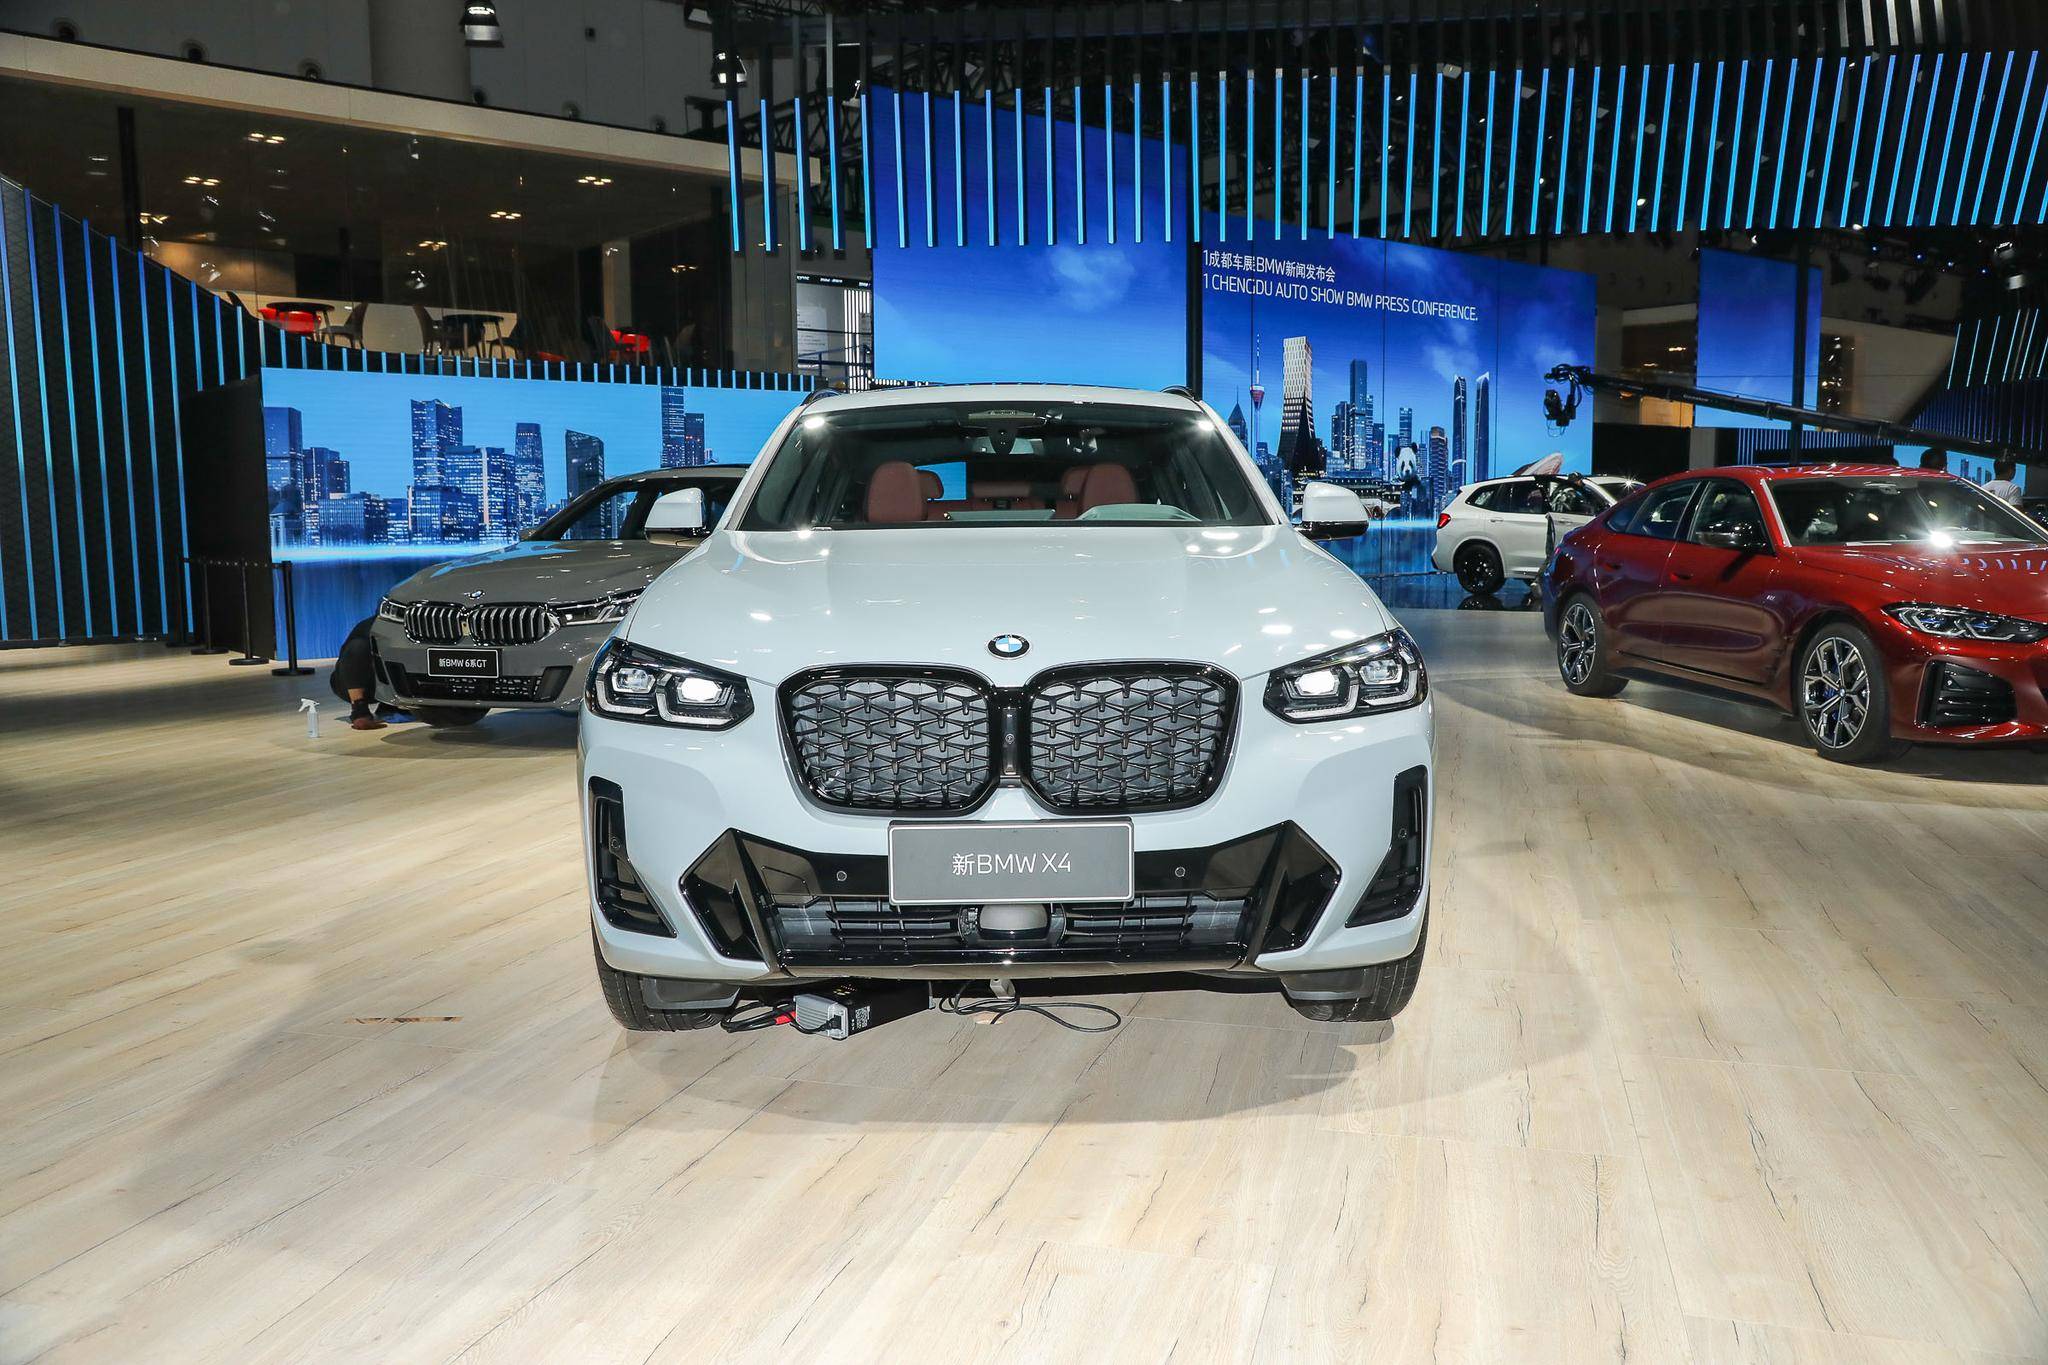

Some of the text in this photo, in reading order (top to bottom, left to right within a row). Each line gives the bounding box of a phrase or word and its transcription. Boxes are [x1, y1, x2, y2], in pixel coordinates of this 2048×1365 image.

[1211, 274, 1273, 296] CHENGDU
[1275, 282, 1308, 301] AUTO
[1310, 286, 1344, 305] SHOW
[1346, 291, 1373, 309] BMW
[1375, 295, 1410, 313] PRESS
[1411, 299, 1478, 321] CONFERENCE.
[952, 852, 1072, 876] 新BMW X4
